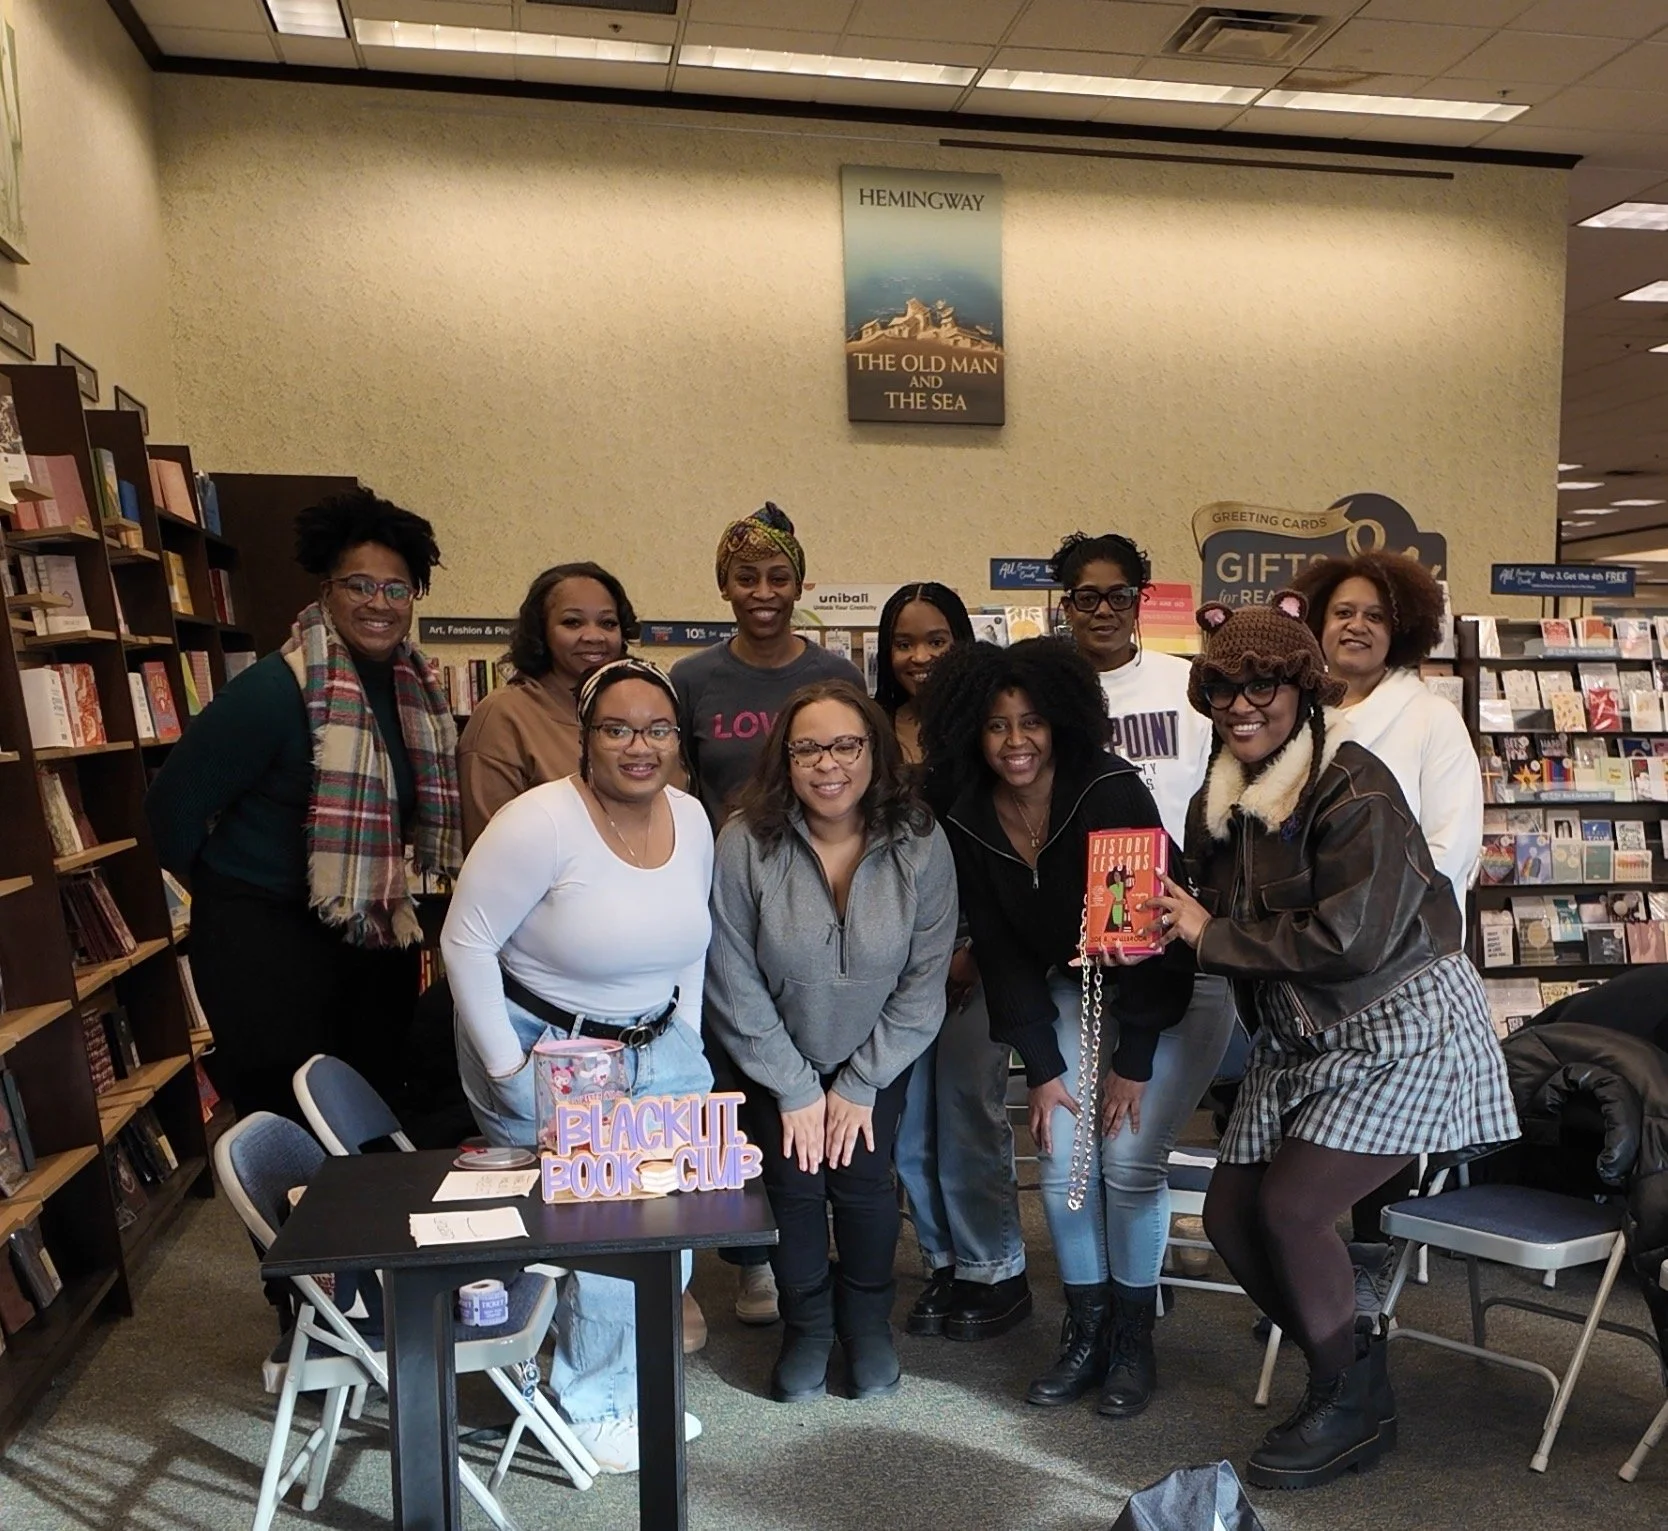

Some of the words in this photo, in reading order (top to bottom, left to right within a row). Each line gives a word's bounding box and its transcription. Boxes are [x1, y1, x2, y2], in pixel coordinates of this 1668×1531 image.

[859, 188, 985, 212] HEMINGWAY
[852, 353, 897, 372] THE
[901, 354, 946, 373] OLD
[950, 356, 998, 375] MAN
[909, 375, 943, 389] AND
[883, 391, 928, 410] THE
[931, 392, 967, 411] SEA
[1212, 511, 1279, 527] GREETING
[1282, 517, 1328, 530] CARDS
[1605, 571, 1628, 582] FREE
[819, 592, 869, 604] uniball
[1218, 588, 1239, 604] for
[429, 626, 446, 635] Art,
[447, 625, 483, 635] Fashion
[484, 626, 493, 635] &
[494, 626, 514, 635] Pho
[1108, 710, 1179, 762] POINT
[1093, 836, 1150, 855] HISTORY
[1092, 854, 1150, 874] LESSONS
[541, 1152, 644, 1203] BOOK
[673, 1144, 763, 1192] CLUB
[481, 1299, 504, 1309] TICKET
